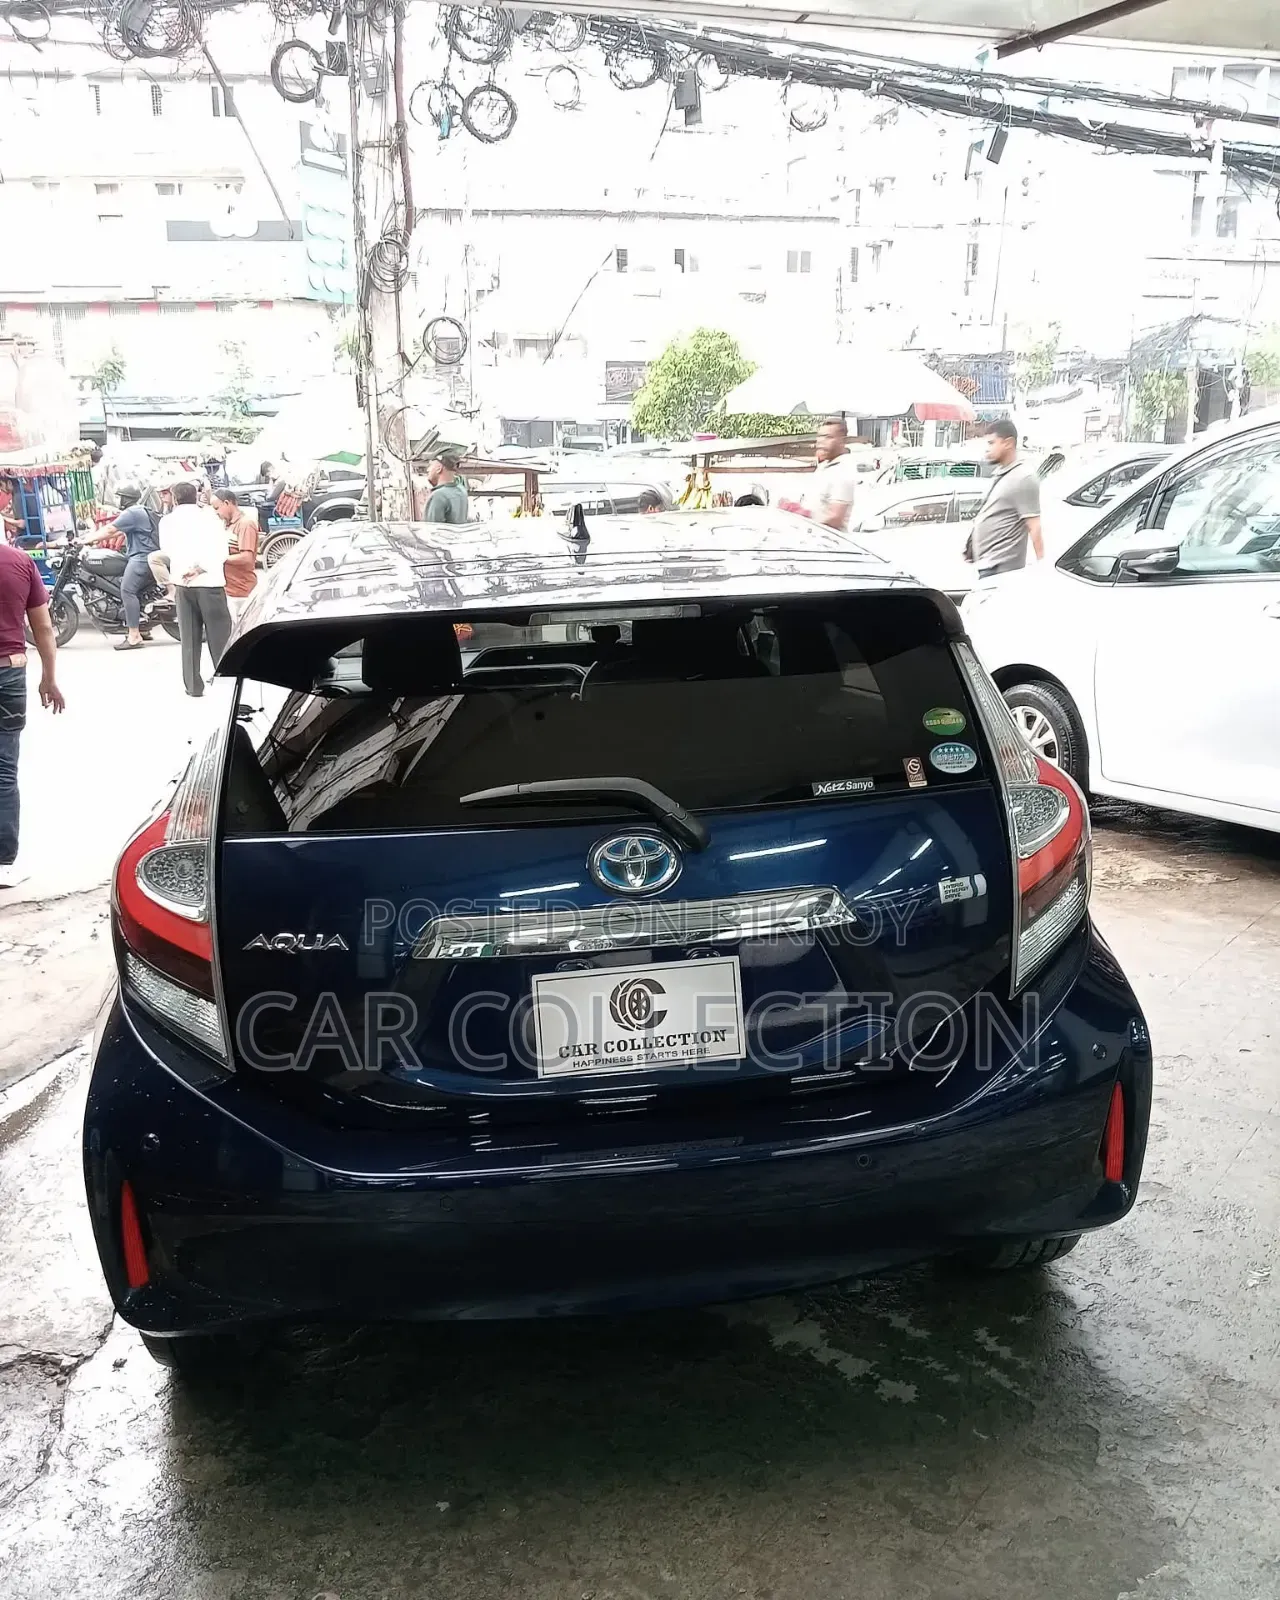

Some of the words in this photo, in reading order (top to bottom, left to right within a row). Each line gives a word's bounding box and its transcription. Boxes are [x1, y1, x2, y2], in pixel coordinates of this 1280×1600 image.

[845, 781, 874, 791] Sanyo
[943, 882, 964, 890] HYBRID
[944, 886, 969, 895] SYNERGY
[242, 932, 349, 954] AQUA
[558, 1043, 600, 1059] CAR
[603, 1029, 728, 1054] COLLECTION
[572, 1055, 634, 1069] HAPPINESS
[636, 1050, 678, 1061] STARTS
[681, 1046, 711, 1057] HERE
